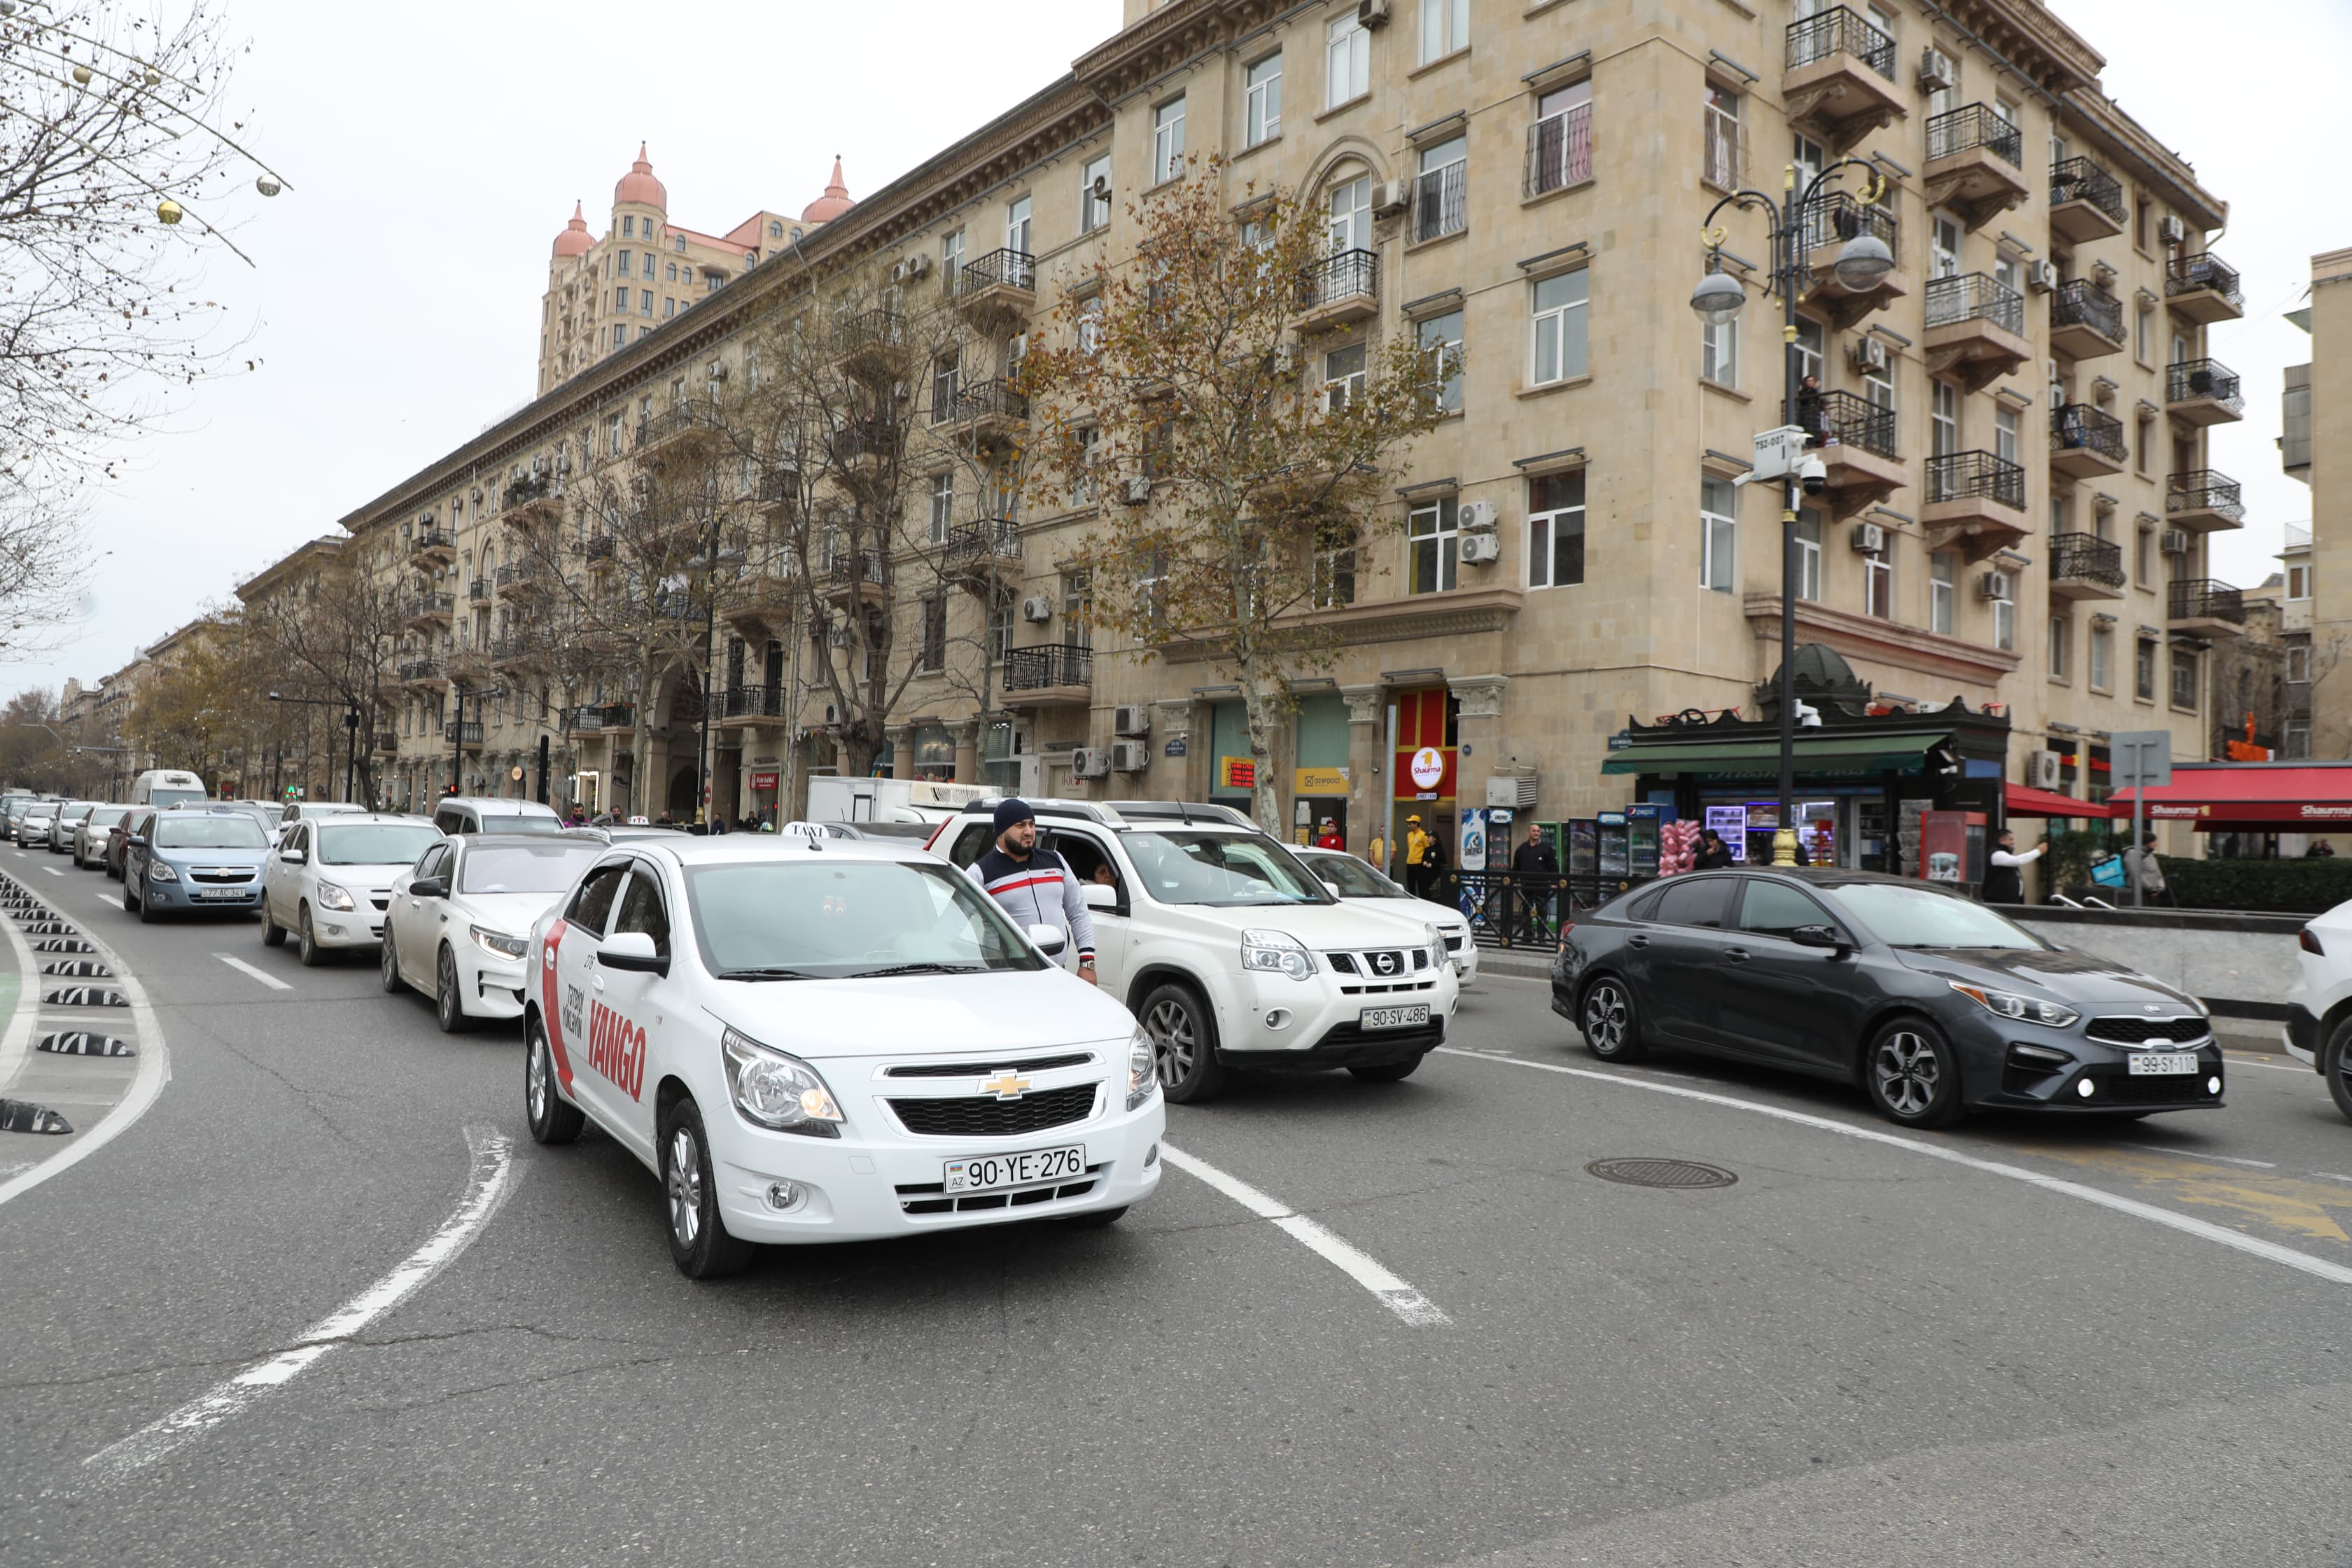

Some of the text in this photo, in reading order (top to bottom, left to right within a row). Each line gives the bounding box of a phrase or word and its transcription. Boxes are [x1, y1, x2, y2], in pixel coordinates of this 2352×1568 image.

[1636, 808, 1654, 816] pepsi
[2150, 805, 2198, 814] Shaurma
[792, 825, 822, 837] TAXI
[584, 954, 596, 970] 276
[1373, 1007, 1427, 1026] 90-SV-486
[588, 998, 645, 1103] YANGO
[951, 1149, 1080, 1187] AZ 90-YE-276
